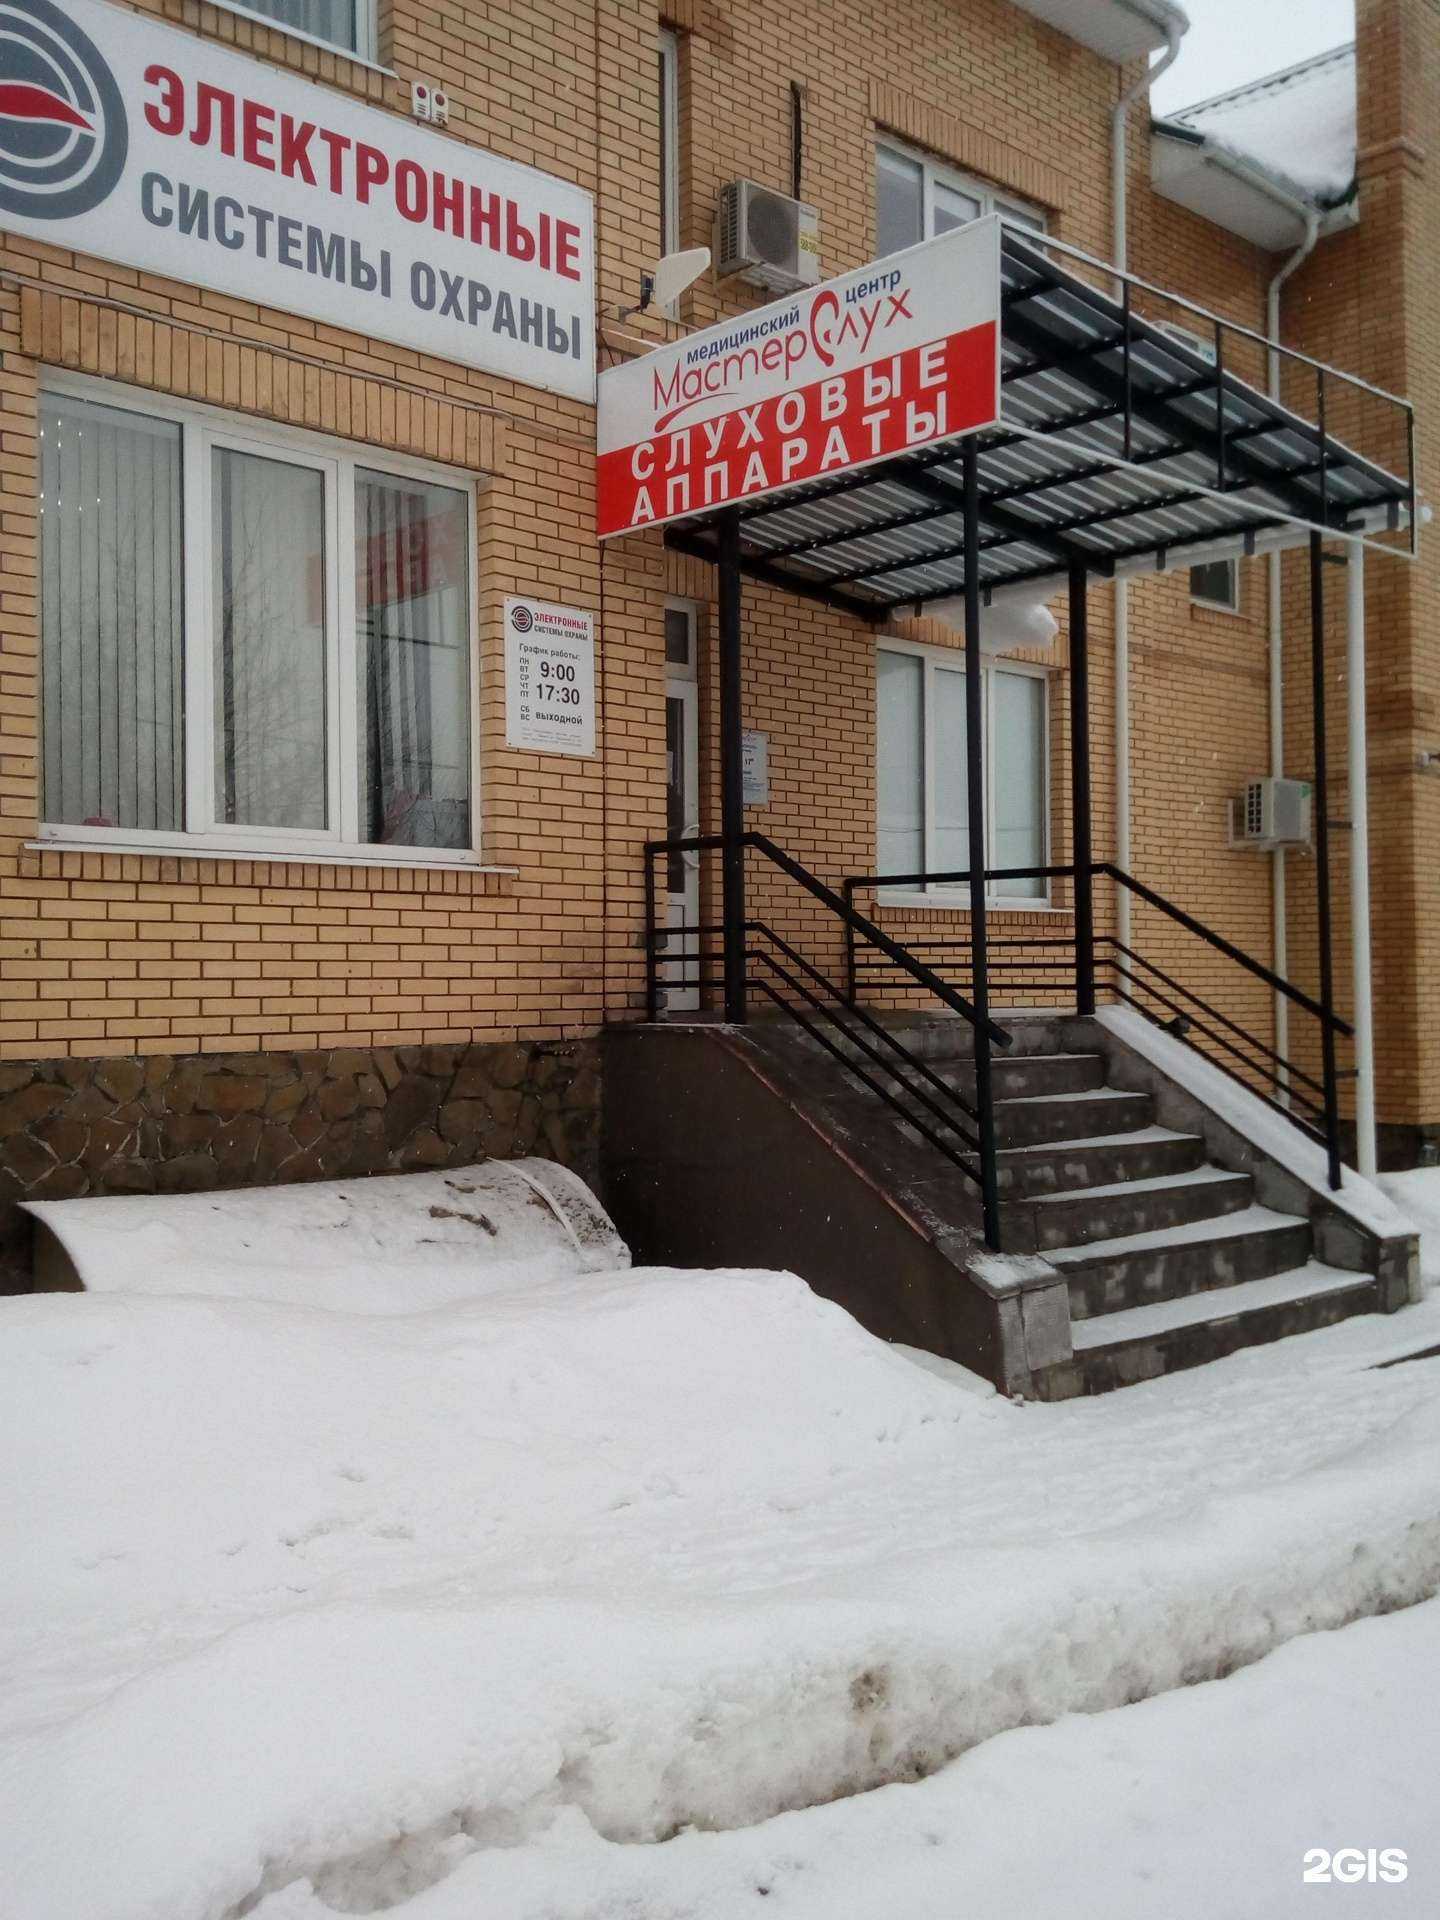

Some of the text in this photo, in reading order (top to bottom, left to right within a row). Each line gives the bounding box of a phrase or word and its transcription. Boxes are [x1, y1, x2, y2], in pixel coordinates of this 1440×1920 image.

[143, 64, 581, 282] ЭЛЕКТРОННЫЕ
[141, 171, 581, 360] СИСТЕМЫ ОХРАНЫ
[687, 270, 901, 364] медицинский центр
[631, 339, 949, 482] СЛУХОВЫЕ
[631, 391, 948, 526] АППАРАТЫ
[519, 643, 549, 655] График
[534, 612, 588, 631] ЭЛЕКТРОННЫЕ
[534, 625, 588, 641] СИСТЕМЫ ОХРАНЫ
[536, 683, 580, 705] 17:30
[540, 661, 575, 682] 9:00
